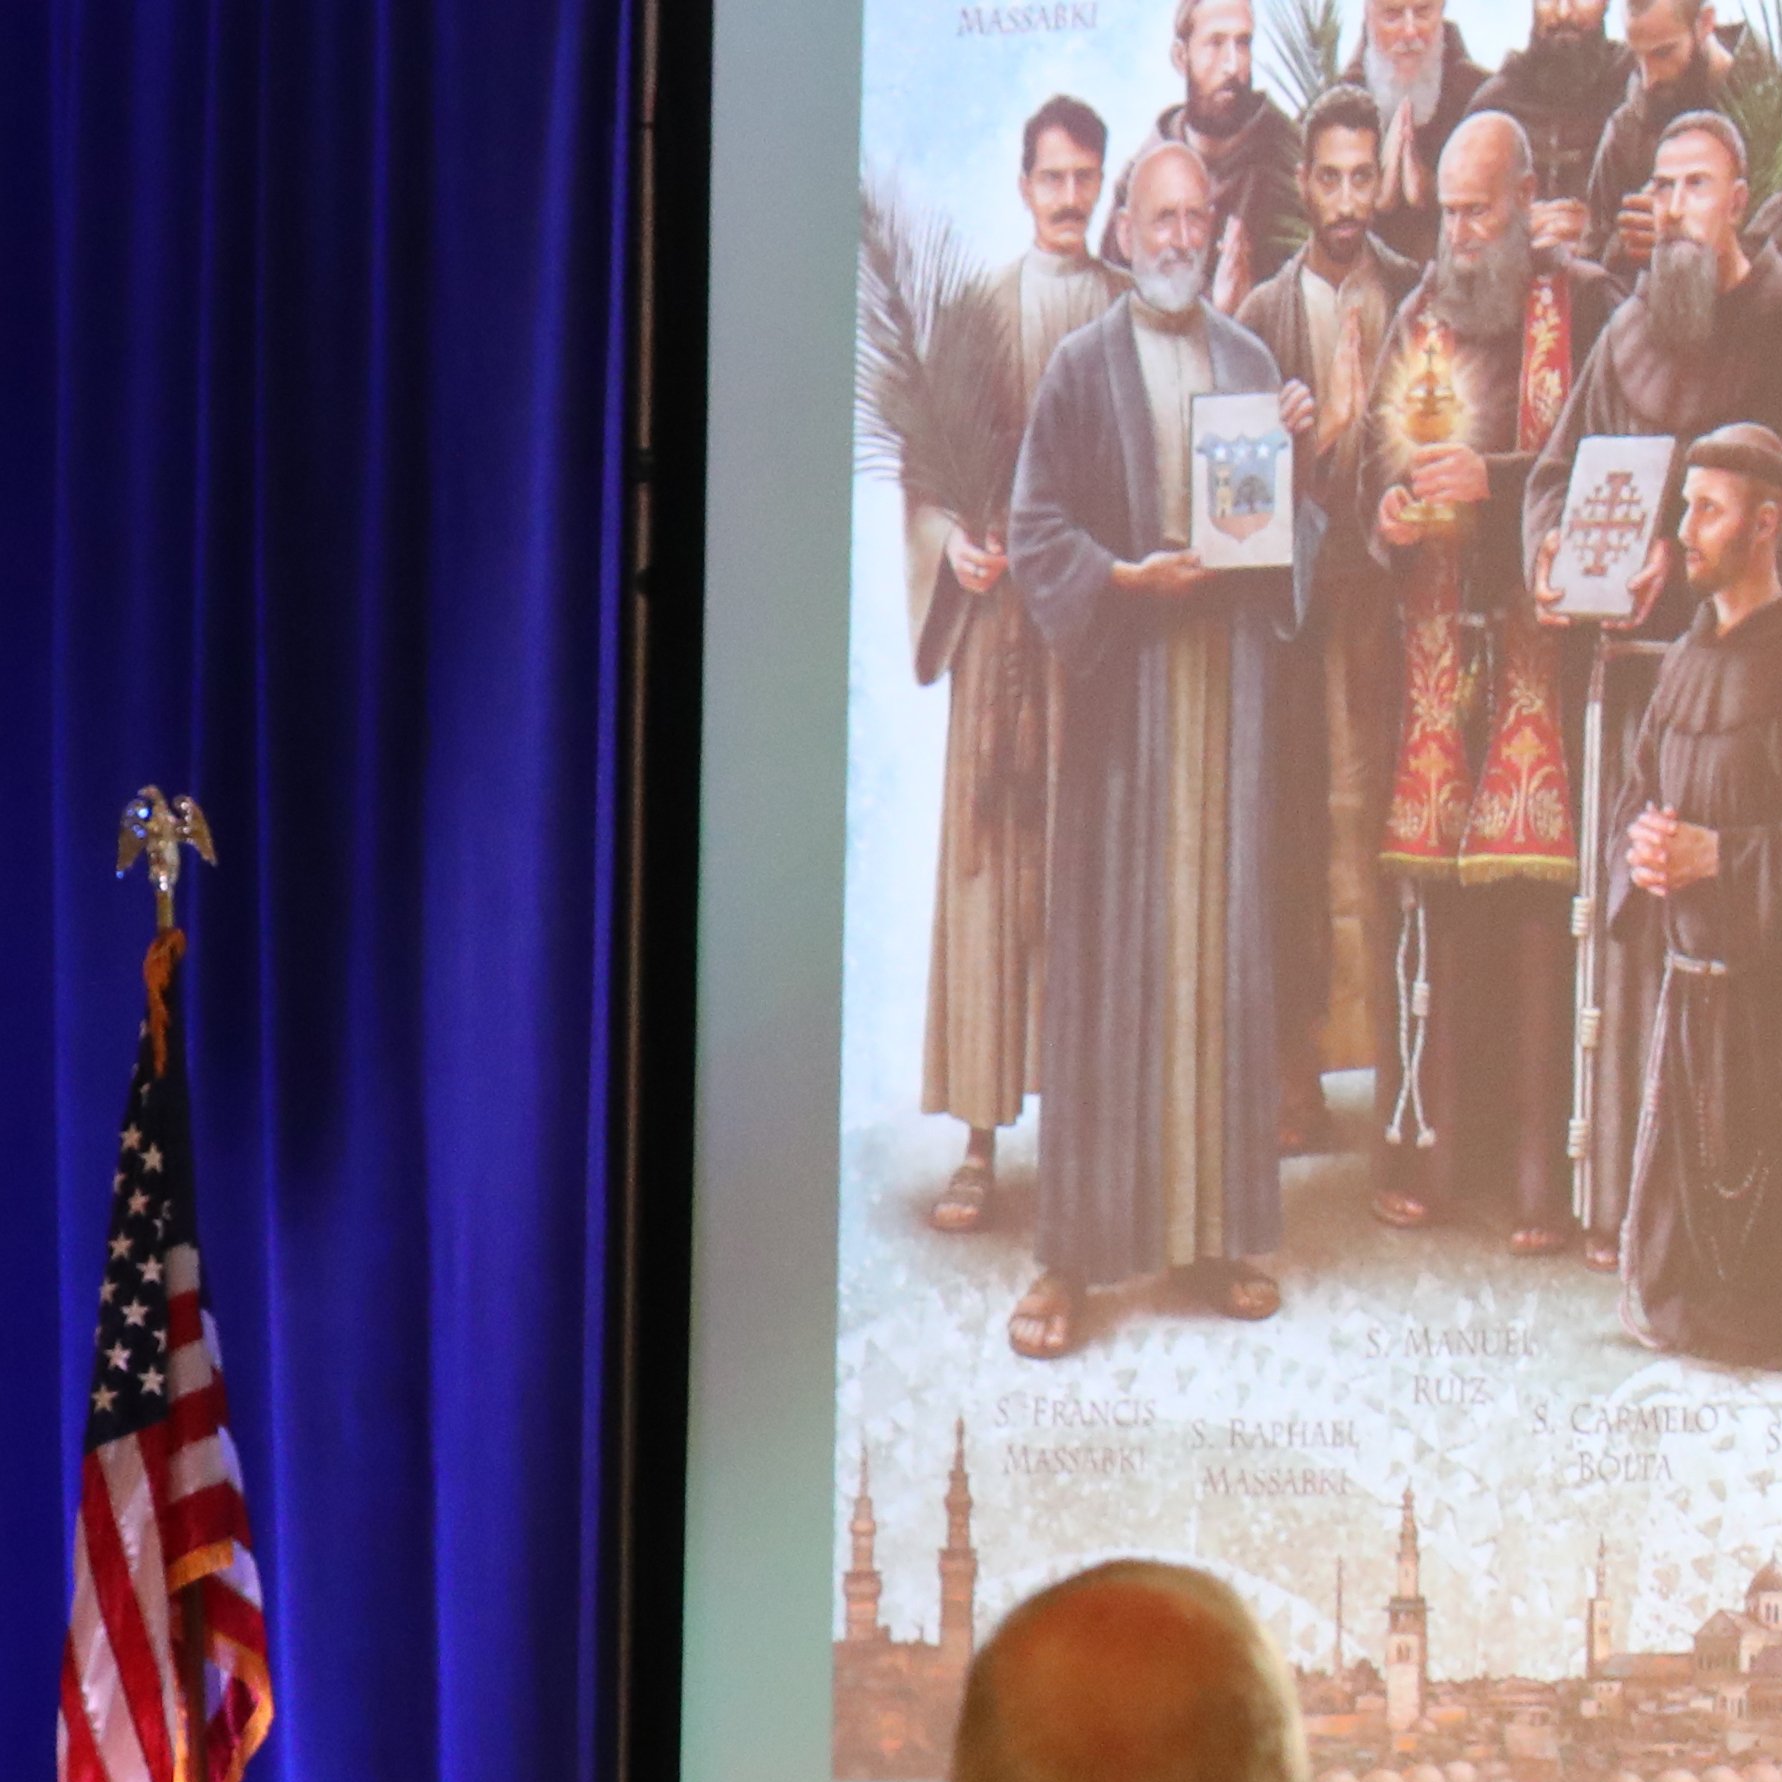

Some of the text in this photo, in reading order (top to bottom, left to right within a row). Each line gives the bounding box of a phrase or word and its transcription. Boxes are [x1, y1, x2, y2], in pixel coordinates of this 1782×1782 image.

[956, 2, 1098, 36] MASSABKI
[1404, 1326, 1535, 1358] MANUEL
[1414, 1375, 1488, 1405] RUIZ
[1033, 1397, 1158, 1428] FRANCIS
[1570, 1402, 1719, 1435] CARMELO
[1229, 1418, 1361, 1449] RAPHAEL
[1578, 1451, 1673, 1484] BOLTA
